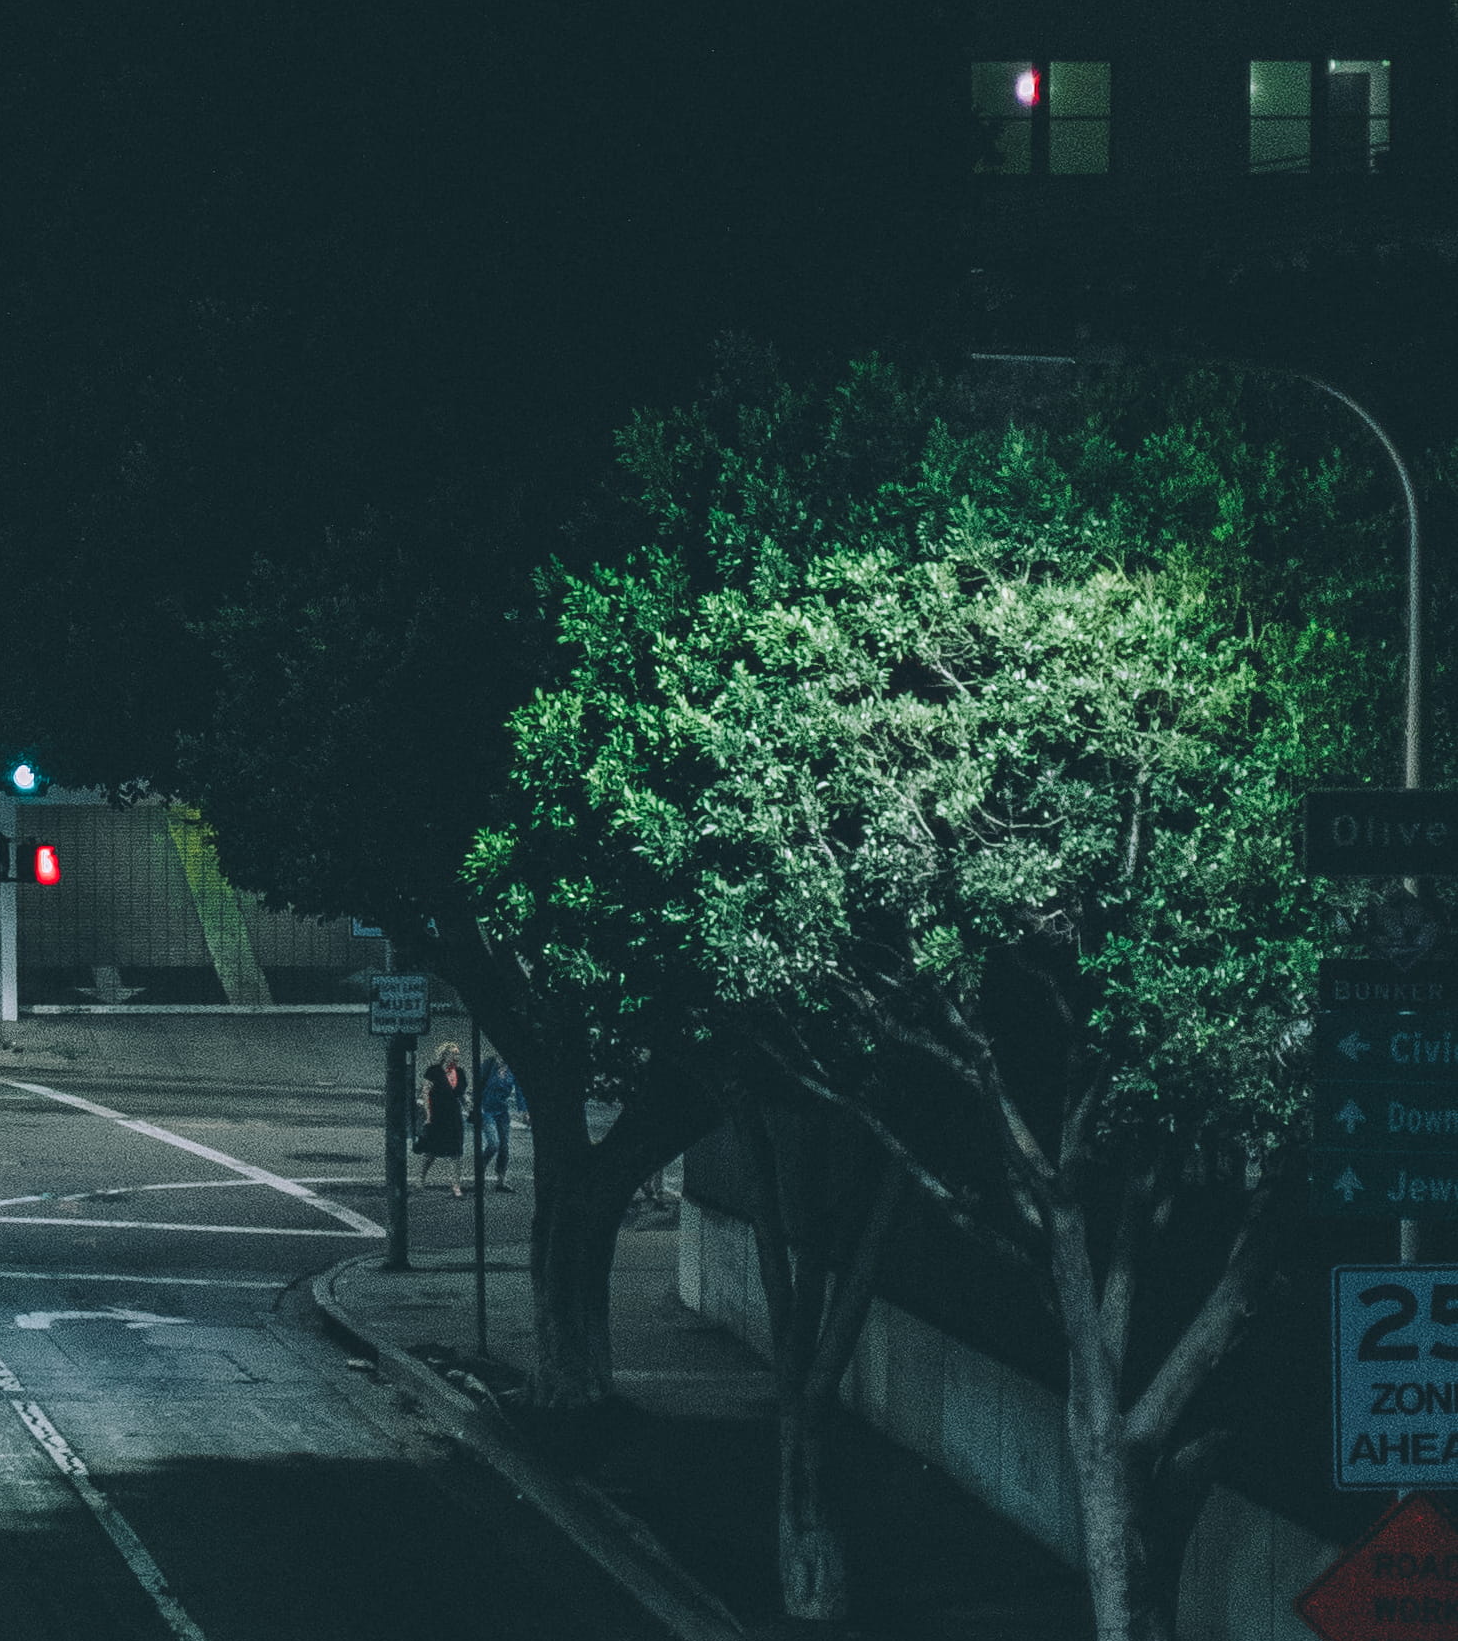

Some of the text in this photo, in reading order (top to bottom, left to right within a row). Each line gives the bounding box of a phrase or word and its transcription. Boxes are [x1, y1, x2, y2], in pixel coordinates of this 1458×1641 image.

[1332, 813, 1449, 847] Olive
[1389, 1031, 1458, 1065] Civi
[1386, 1170, 1458, 1203] Jew
